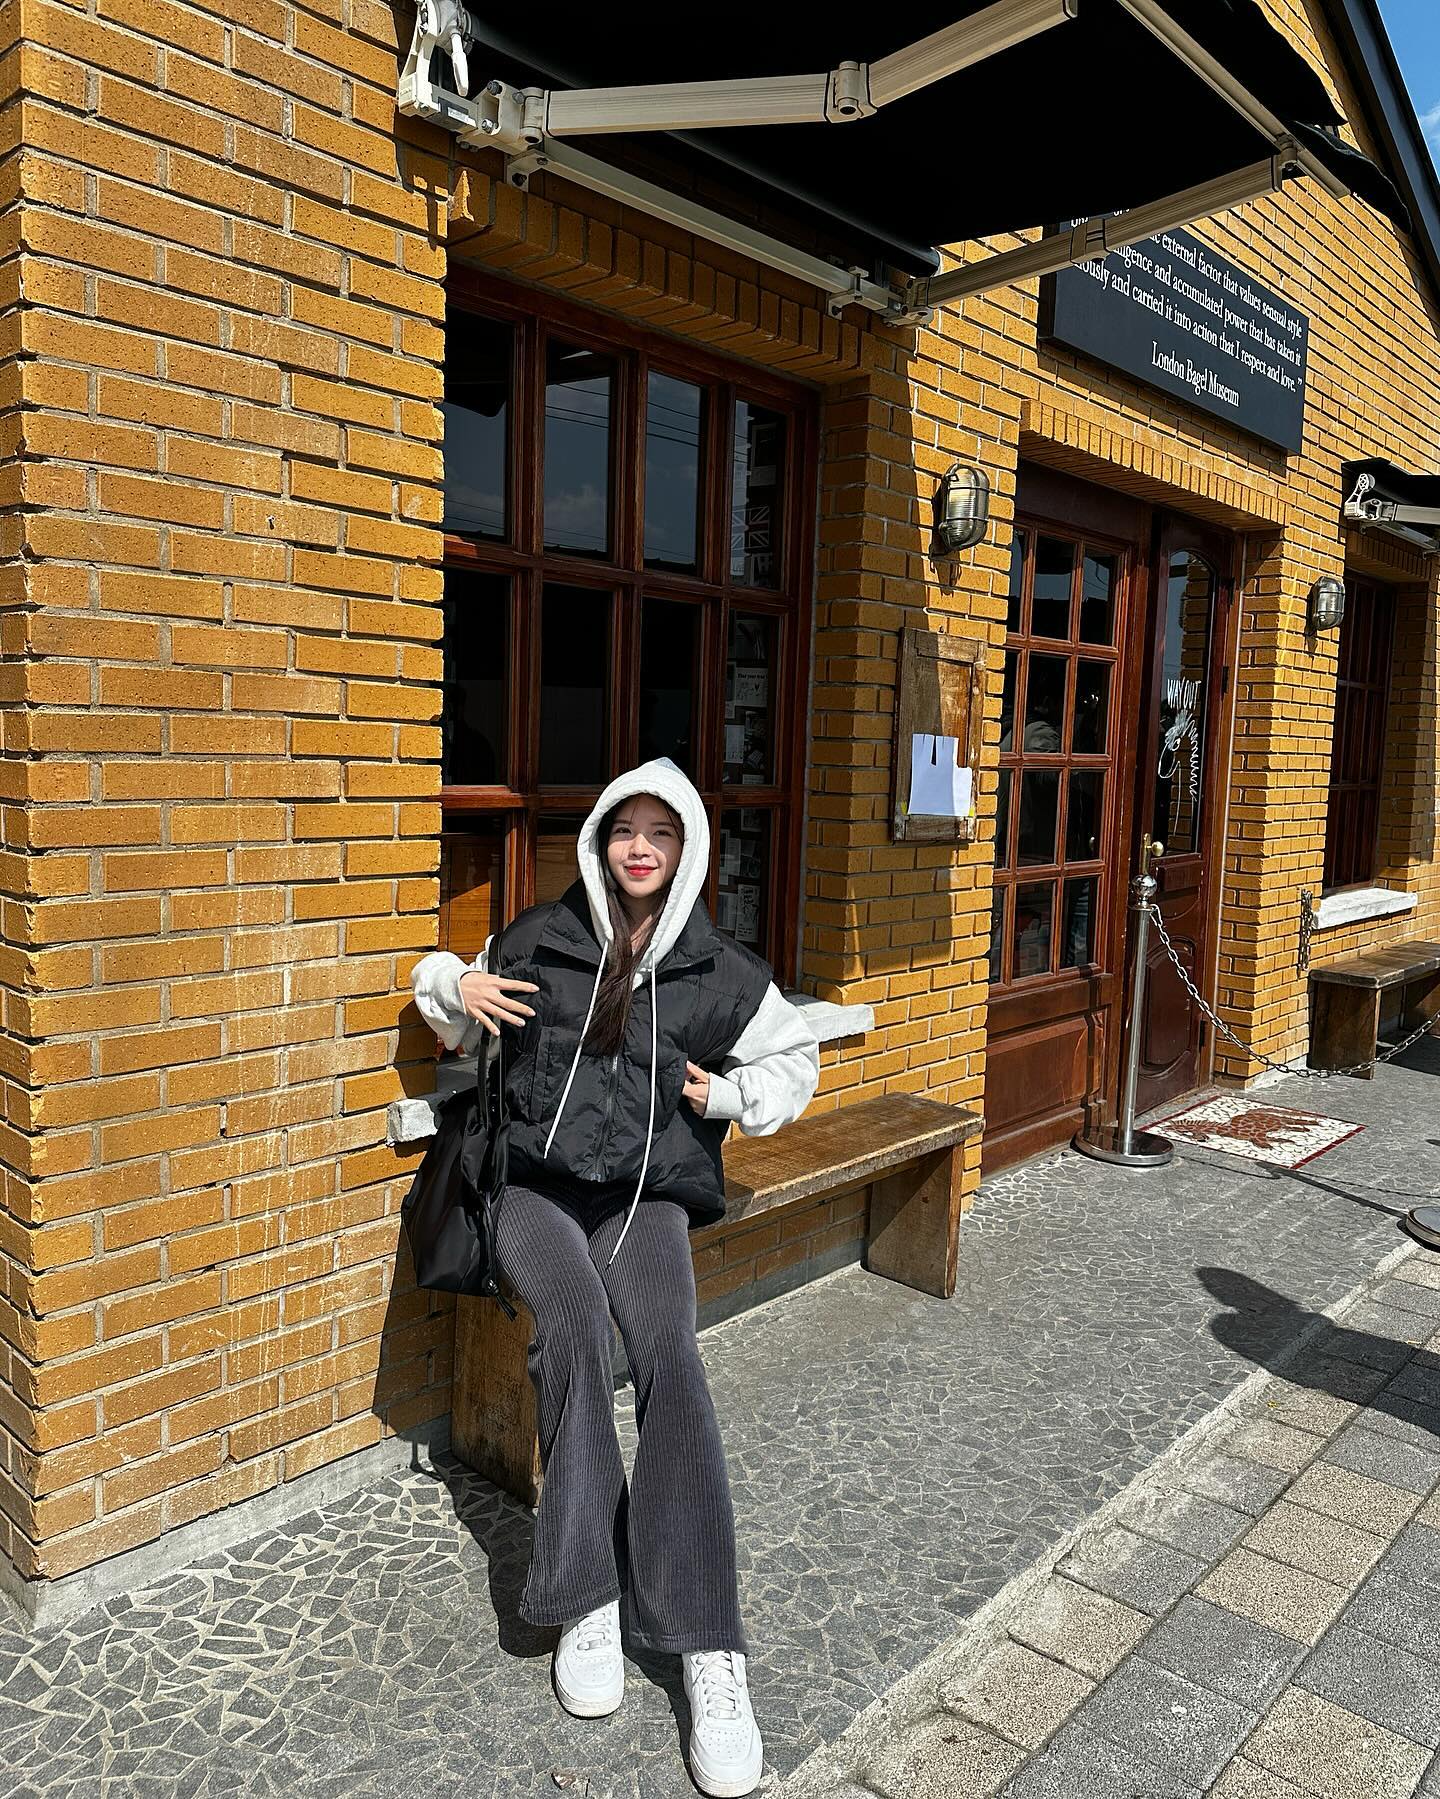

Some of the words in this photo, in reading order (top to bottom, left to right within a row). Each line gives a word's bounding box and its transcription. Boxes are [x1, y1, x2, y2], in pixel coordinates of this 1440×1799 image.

[1111, 274, 1130, 297] and
[1132, 286, 1164, 316] carried
[1165, 298, 1172, 321] it
[1174, 304, 1191, 331] into
[1193, 322, 1217, 347] action
[1219, 332, 1234, 357] that
[1236, 340, 1241, 360] I
[1241, 348, 1266, 374] respect
[1267, 365, 1280, 383] and
[1154, 265, 1171, 287] and
[1172, 276, 1223, 318] accumulated
[1224, 308, 1248, 333] power
[1249, 319, 1263, 343] that
[1264, 328, 1276, 351] has
[1277, 340, 1295, 363] taken
[1295, 348, 1301, 367] it
[1162, 234, 1197, 268] external
[1198, 252, 1222, 284] factor
[1223, 270, 1238, 296] that
[1240, 285, 1262, 311] values
[1262, 302, 1287, 329] sensual
[1287, 319, 1303, 340] style
[1152, 340, 1185, 380] London
[1186, 359, 1208, 396] Bagel
[1208, 370, 1240, 407] Museum
[1167, 676, 1186, 710] WAY
[1183, 679, 1202, 710] OUT
